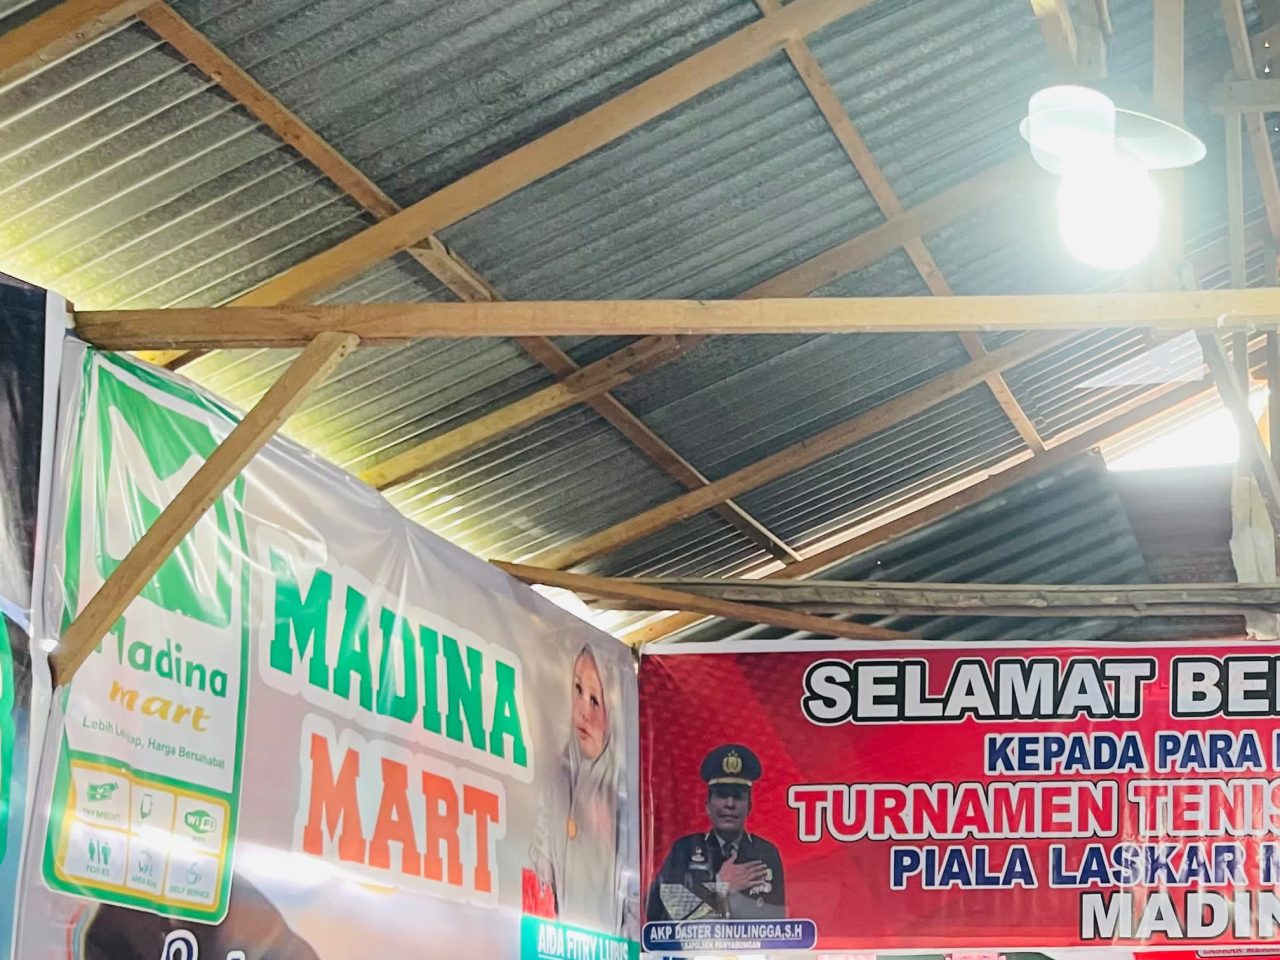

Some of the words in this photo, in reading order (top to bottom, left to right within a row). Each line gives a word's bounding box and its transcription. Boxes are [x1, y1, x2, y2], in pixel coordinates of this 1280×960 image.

[269, 551, 528, 768] MADINA
[109, 680, 211, 733] mart
[803, 656, 1156, 725] SELAMAT
[147, 738, 178, 757] Harga
[985, 731, 1143, 774] KEPADA
[1156, 728, 1265, 772] PARA
[302, 733, 499, 893] MART
[789, 782, 1119, 843] TURNAMEN
[891, 843, 1039, 889] PIALA
[1049, 840, 1246, 888] LASKAR
[538, 924, 564, 956] AIDA
[650, 926, 672, 940] AKP
[675, 925, 711, 939] DASTER
